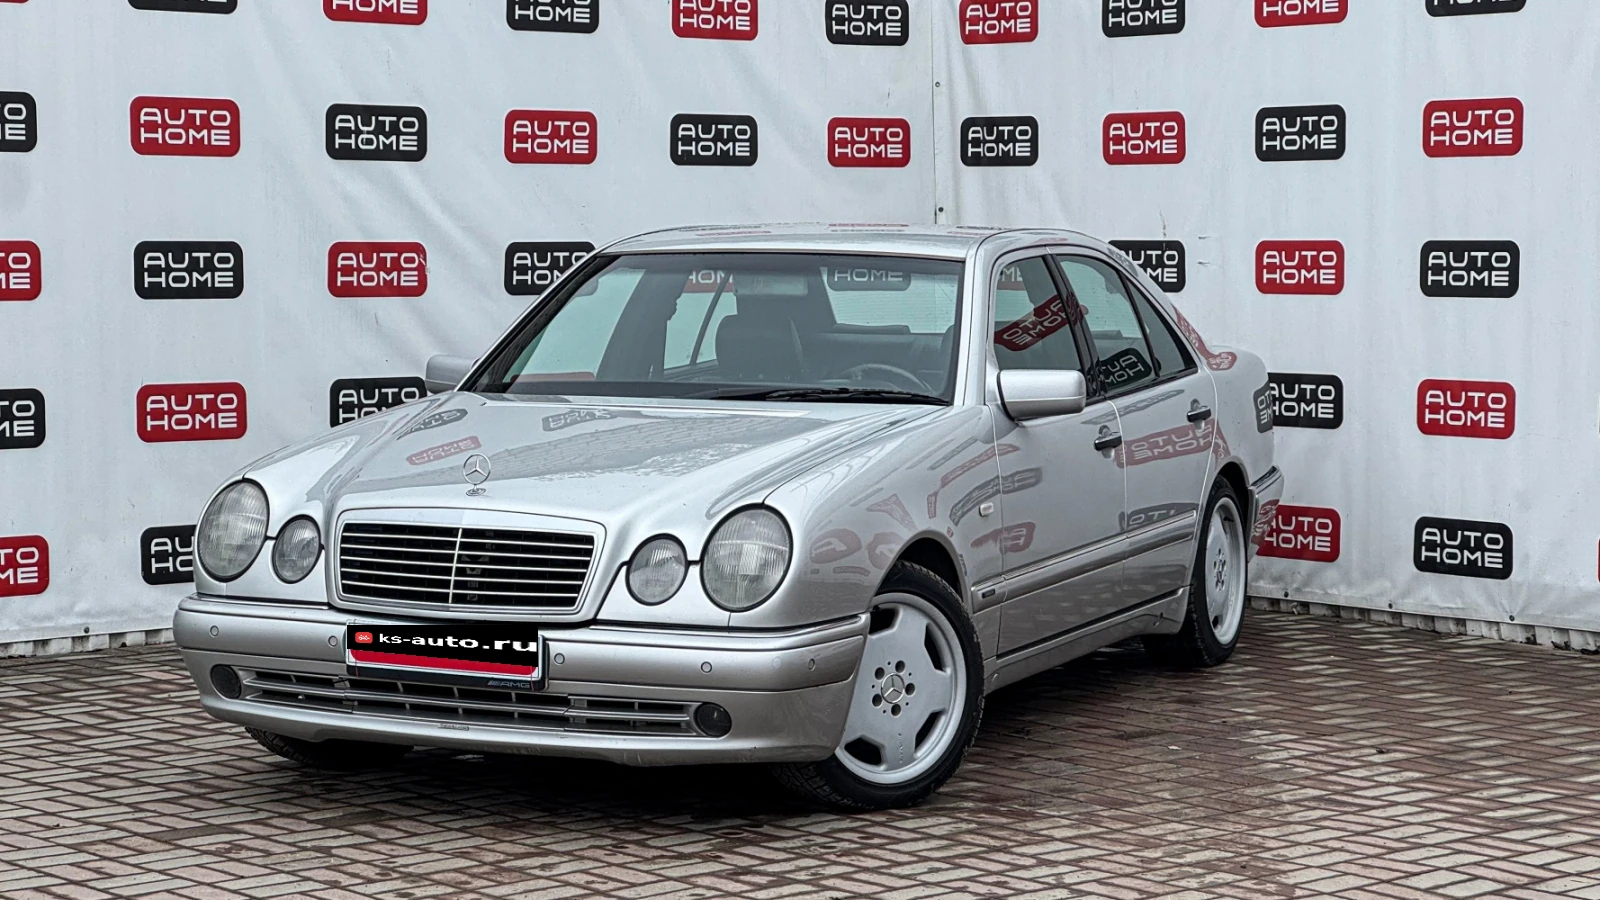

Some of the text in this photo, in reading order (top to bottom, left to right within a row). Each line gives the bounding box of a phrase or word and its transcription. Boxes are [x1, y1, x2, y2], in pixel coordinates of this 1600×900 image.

[515, 5, 590, 23] HOME
[680, 0, 750, 13] AUTO
[832, 4, 901, 19] AUTO
[966, 2, 1031, 18] AUTO
[1263, 0, 1338, 16] HOME
[680, 14, 750, 30] HOME
[966, 18, 1030, 34] HOME
[1109, 9, 1177, 27] HOME
[832, 21, 901, 36] HOME
[140, 108, 230, 126] AUTO
[335, 115, 418, 133] AUTO
[1263, 116, 1337, 132] AUTO
[1431, 109, 1514, 127] AUTO
[513, 120, 589, 136] AUTO
[679, 124, 750, 139] AUTO
[835, 127, 903, 141] AUTO
[968, 126, 1031, 140] AUTO
[1110, 122, 1178, 137] AUTO
[141, 128, 230, 145] HOME
[335, 134, 417, 150] HOME
[1263, 134, 1336, 150] HOME
[1431, 129, 1512, 146] HOME
[513, 138, 588, 153] HOME
[678, 141, 750, 156] HOME
[835, 144, 902, 157] HOME
[968, 143, 1030, 156] HOME
[1110, 139, 1177, 154] HOME
[144, 253, 234, 268] AUTO
[338, 253, 418, 267] AUTO
[1129, 250, 1178, 265] UTO
[1263, 251, 1336, 266] AUTO
[1429, 252, 1510, 267] AUTO
[144, 272, 233, 287] HOME
[337, 271, 418, 286] HOME
[1147, 267, 1177, 282] ME
[1263, 269, 1335, 284] HOME
[1428, 270, 1509, 286] HOME
[147, 394, 237, 411] AUTO
[339, 388, 419, 405] AUTO
[1426, 390, 1506, 408] AUTO
[147, 412, 237, 430] HOME
[1425, 409, 1505, 428] HOME
[150, 536, 194, 554] AU
[1423, 528, 1503, 549] AUTO
[0, 547, 39, 565] TO
[1422, 546, 1502, 568] HOME
[0, 567, 38, 584] ME
